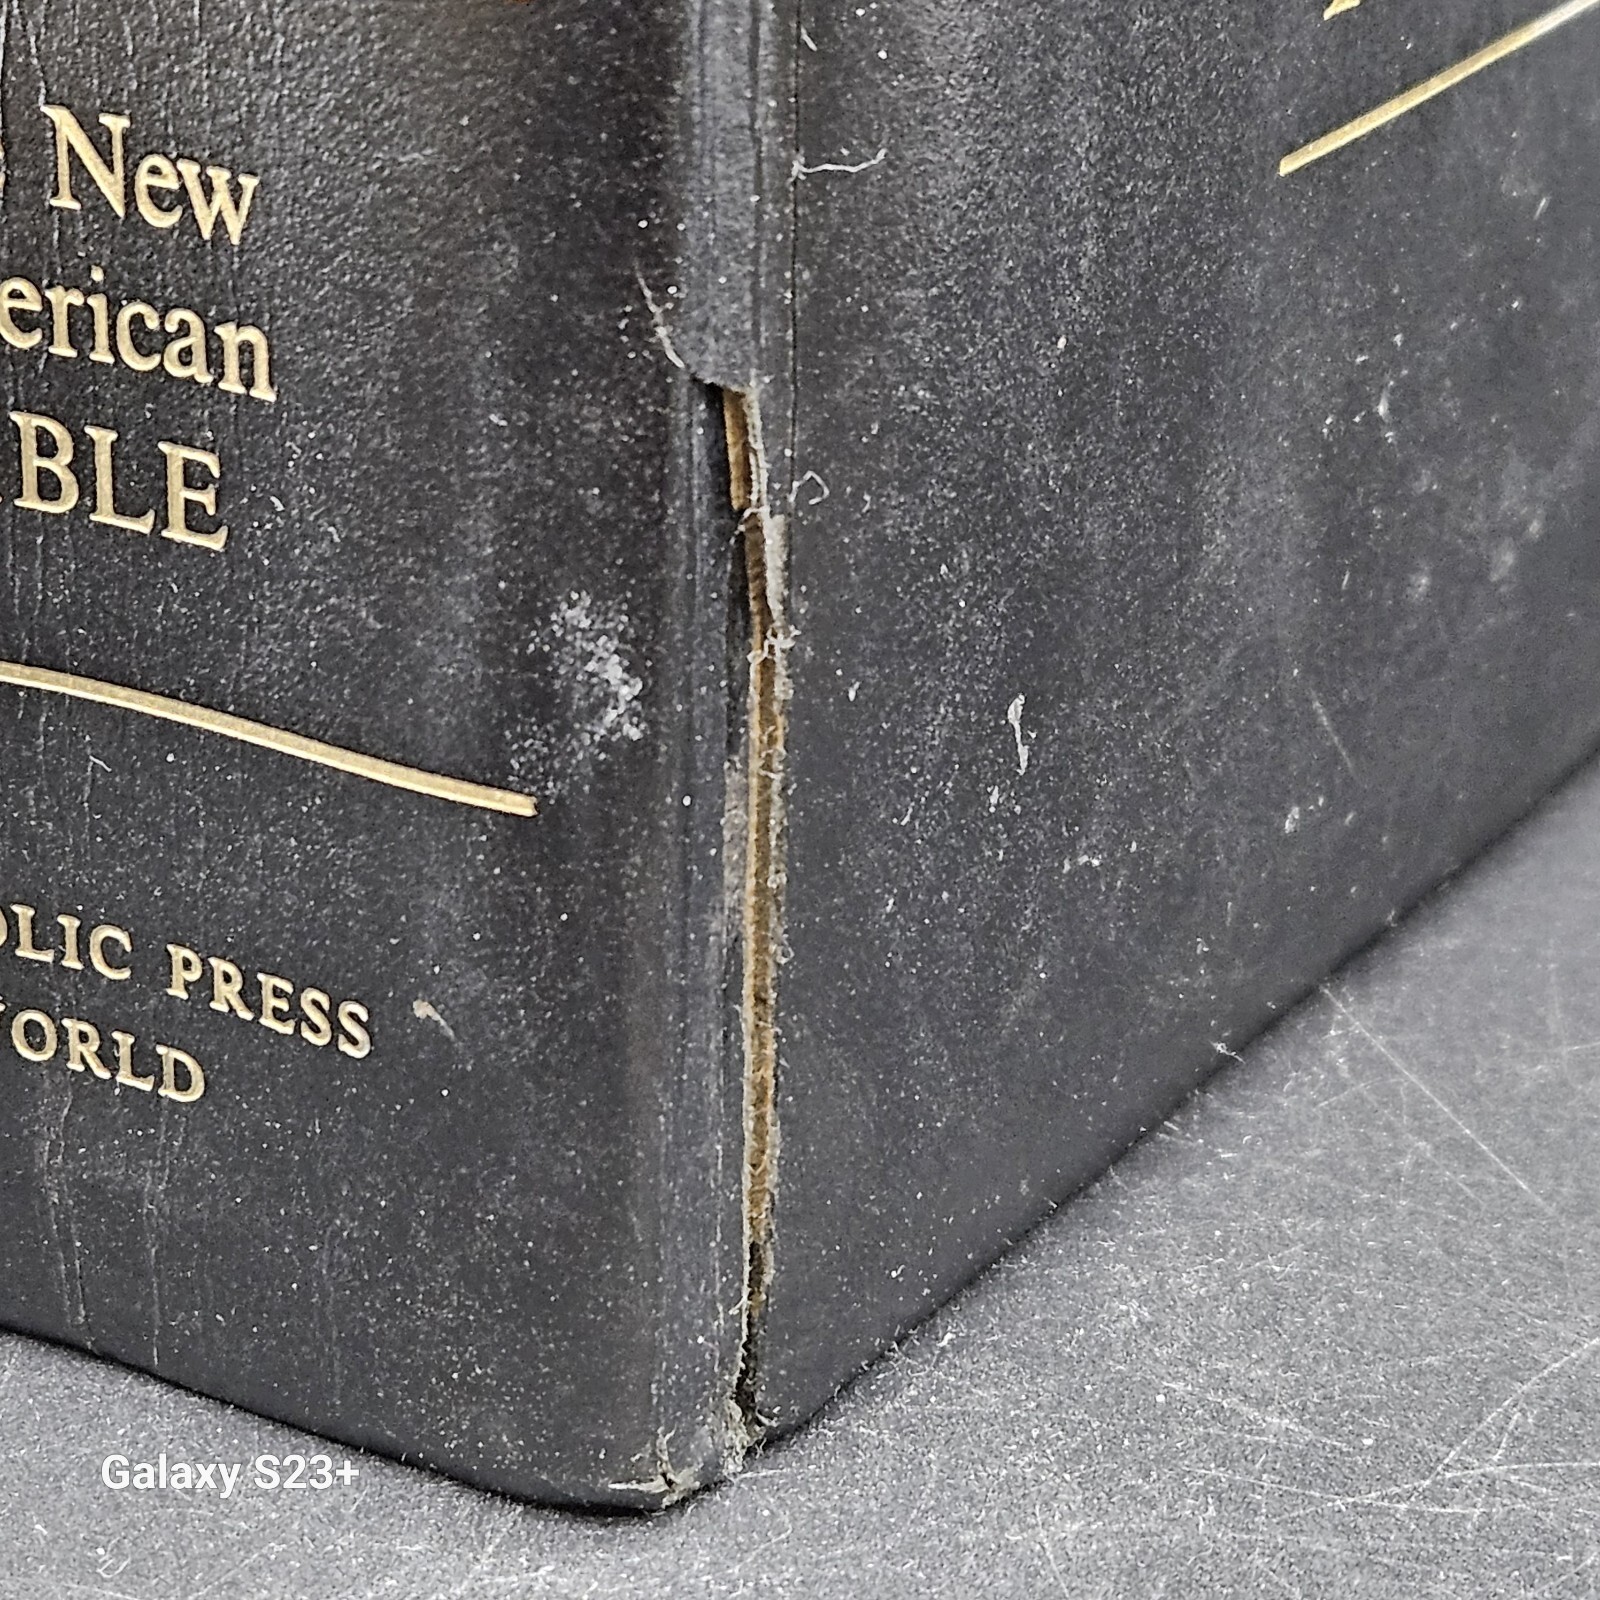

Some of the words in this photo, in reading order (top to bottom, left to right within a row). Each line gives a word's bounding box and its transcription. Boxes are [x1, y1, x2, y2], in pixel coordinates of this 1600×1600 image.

[40, 104, 260, 246] New
[0, 265, 278, 401] erican
[0, 410, 229, 551] BLE
[0, 903, 132, 981] LIC
[165, 943, 372, 1060] PRESS
[0, 996, 206, 1103] ORLD
